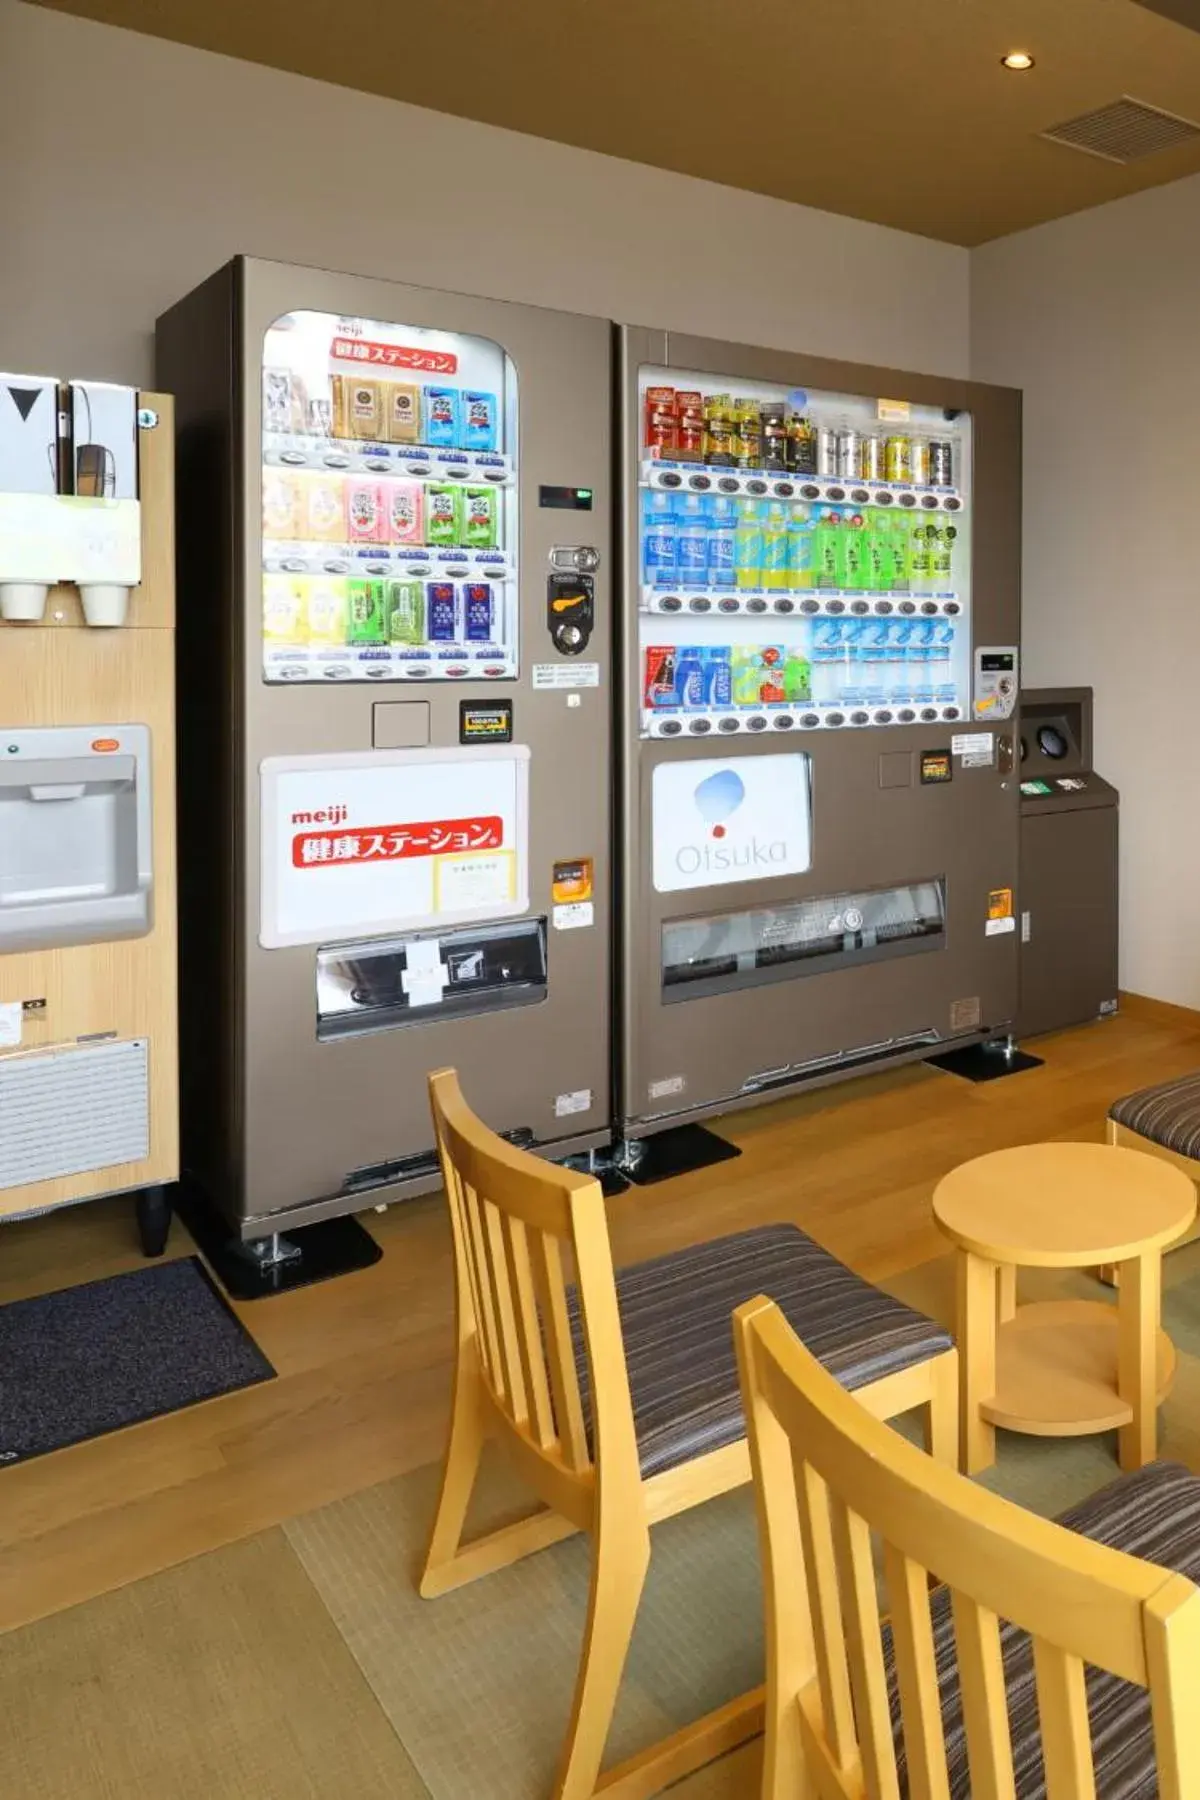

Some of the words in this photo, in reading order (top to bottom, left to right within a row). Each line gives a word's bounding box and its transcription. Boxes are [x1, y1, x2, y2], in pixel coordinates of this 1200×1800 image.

[291, 805, 348, 825] meiji
[302, 824, 492, 863] 健康ステーション
[675, 836, 787, 874] Otsuka
